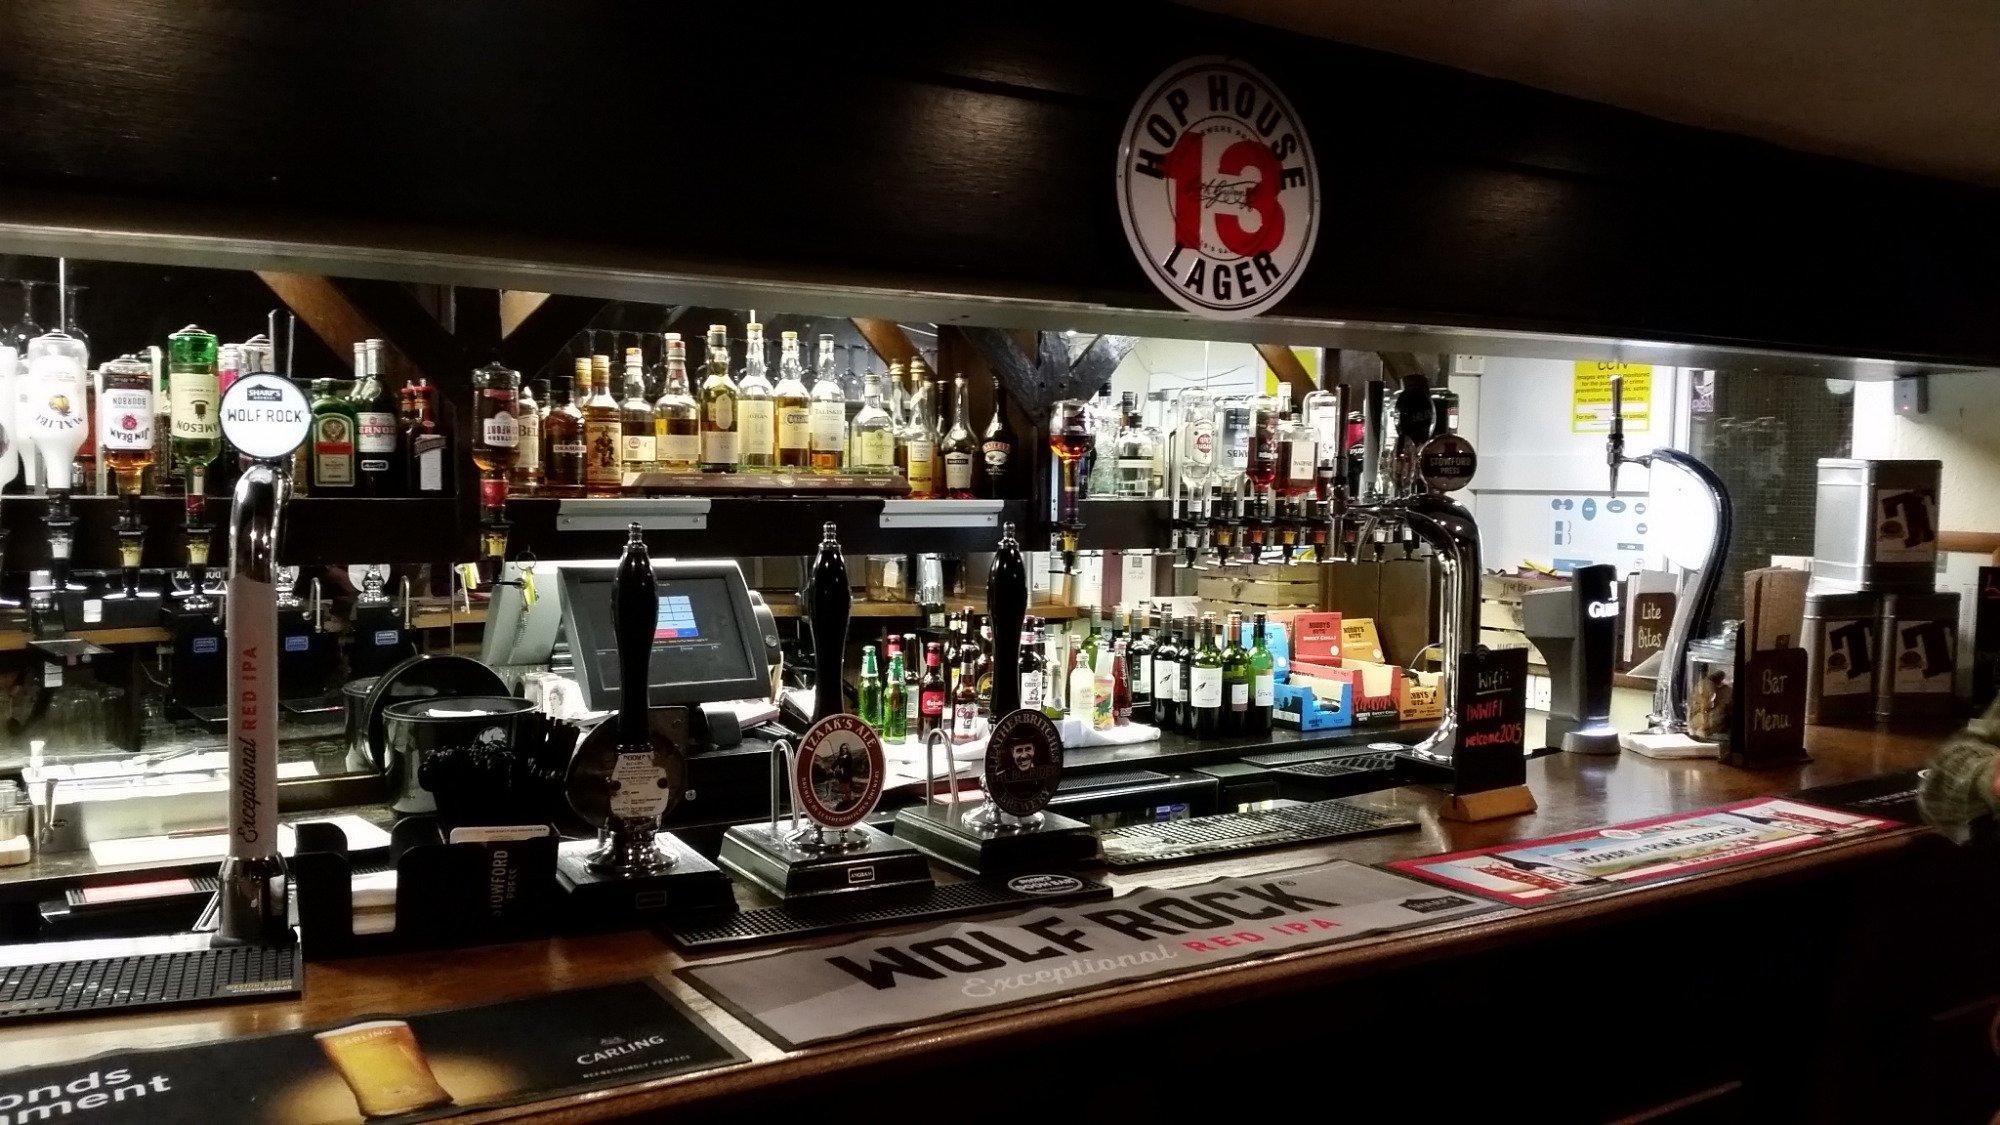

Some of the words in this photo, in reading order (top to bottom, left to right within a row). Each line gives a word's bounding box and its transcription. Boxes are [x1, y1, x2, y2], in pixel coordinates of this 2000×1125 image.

[1135, 87, 1190, 180] HOP
[1207, 74, 1306, 191] HOUSE
[1161, 130, 1286, 258] 13
[1163, 242, 1282, 301] LAGER
[176, 420, 218, 433] AMESON
[227, 409, 261, 422] WOLF
[266, 409, 303, 423] ROCK
[1641, 602, 1662, 620] Lite
[1637, 626, 1662, 649] Bites
[241, 646, 258, 681] IPA
[1762, 668, 1788, 694] Bar
[241, 690, 258, 730] RED
[804, 718, 854, 752] IZAAK'S
[858, 725, 878, 749] ALE
[237, 736, 261, 843] Exceptional
[825, 916, 1095, 990] WOLF
[1083, 882, 1341, 942] ROCK
[961, 943, 1178, 998] Exceptional
[1182, 930, 1265, 953] RED
[1269, 917, 1342, 936] IPA
[576, 1035, 665, 1066] CARLING
